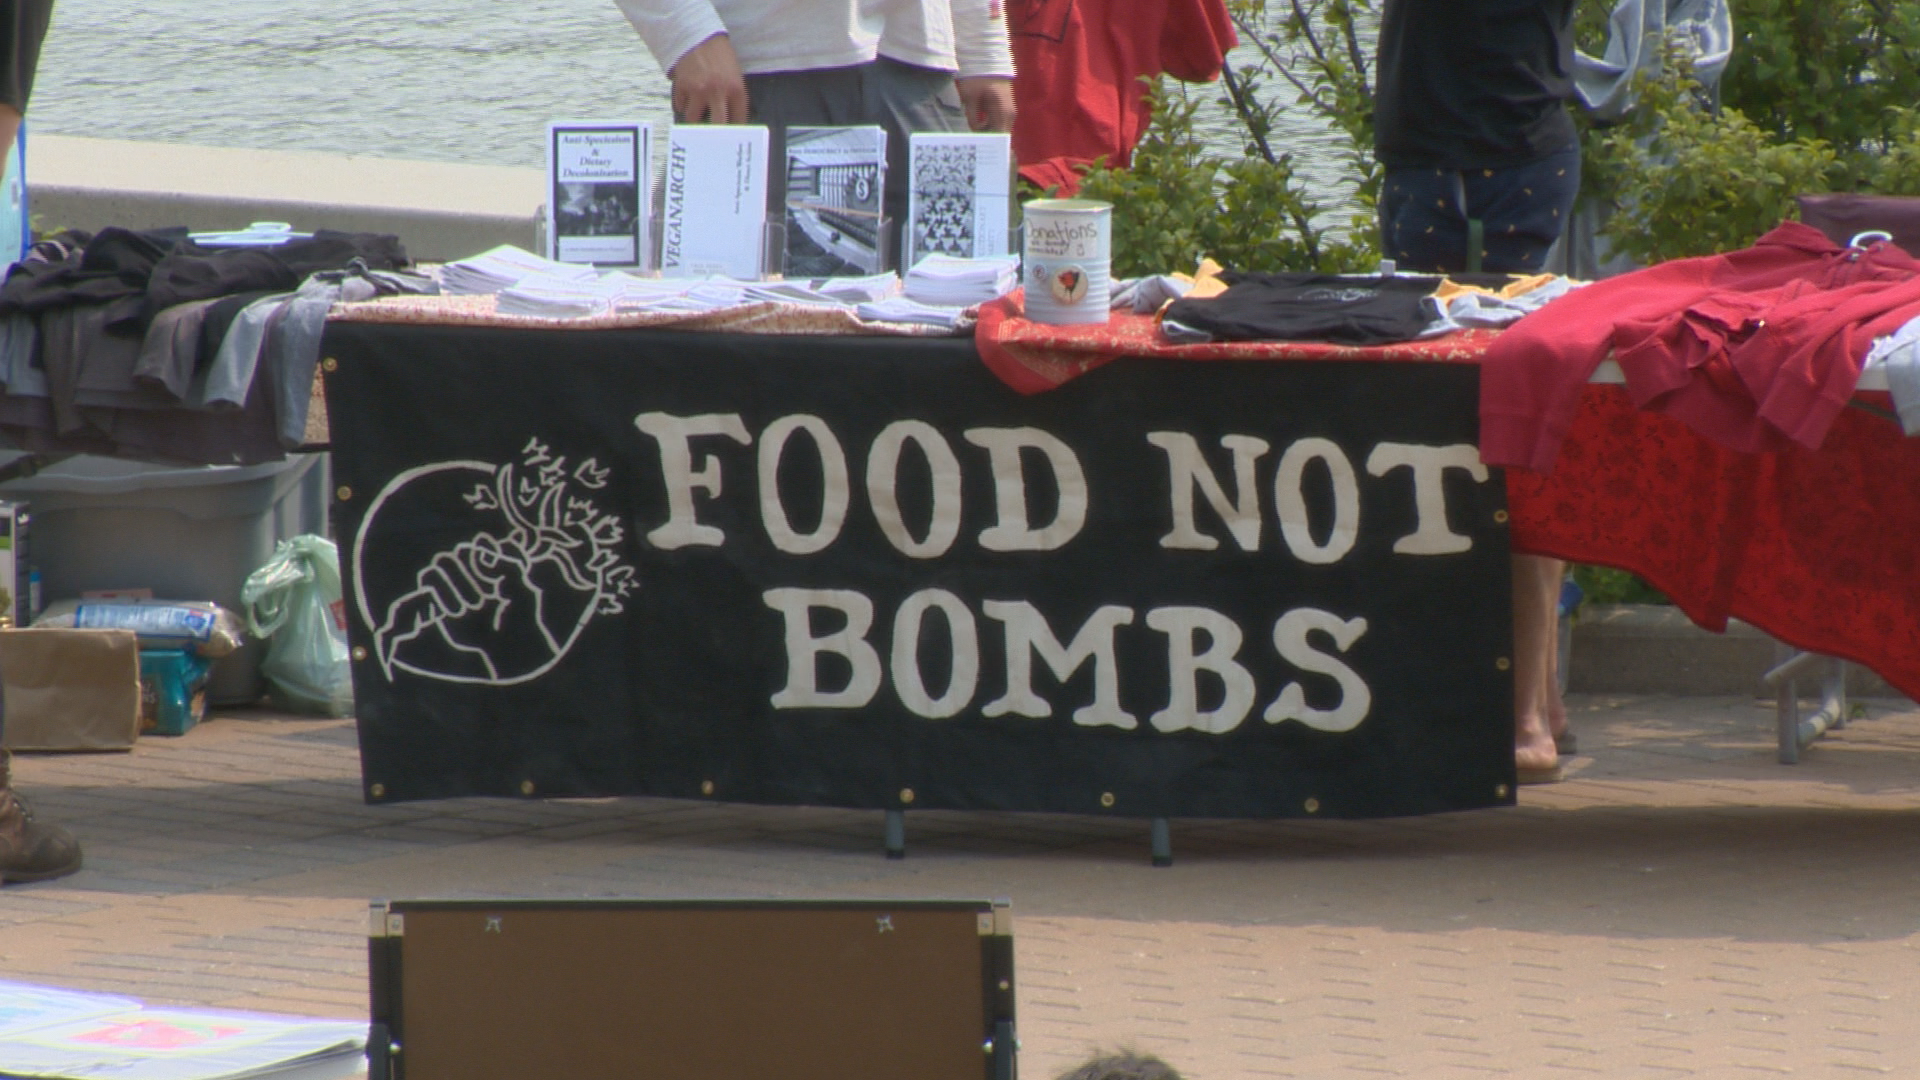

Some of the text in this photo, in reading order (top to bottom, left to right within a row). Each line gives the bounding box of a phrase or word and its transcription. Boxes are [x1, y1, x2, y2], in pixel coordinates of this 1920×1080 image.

[579, 156, 613, 169] Dietary
[665, 140, 687, 269] VEGANARCHY
[1026, 217, 1097, 243] Donations
[634, 411, 1489, 564] FOOD NOT
[762, 587, 1372, 734] BOMBS
